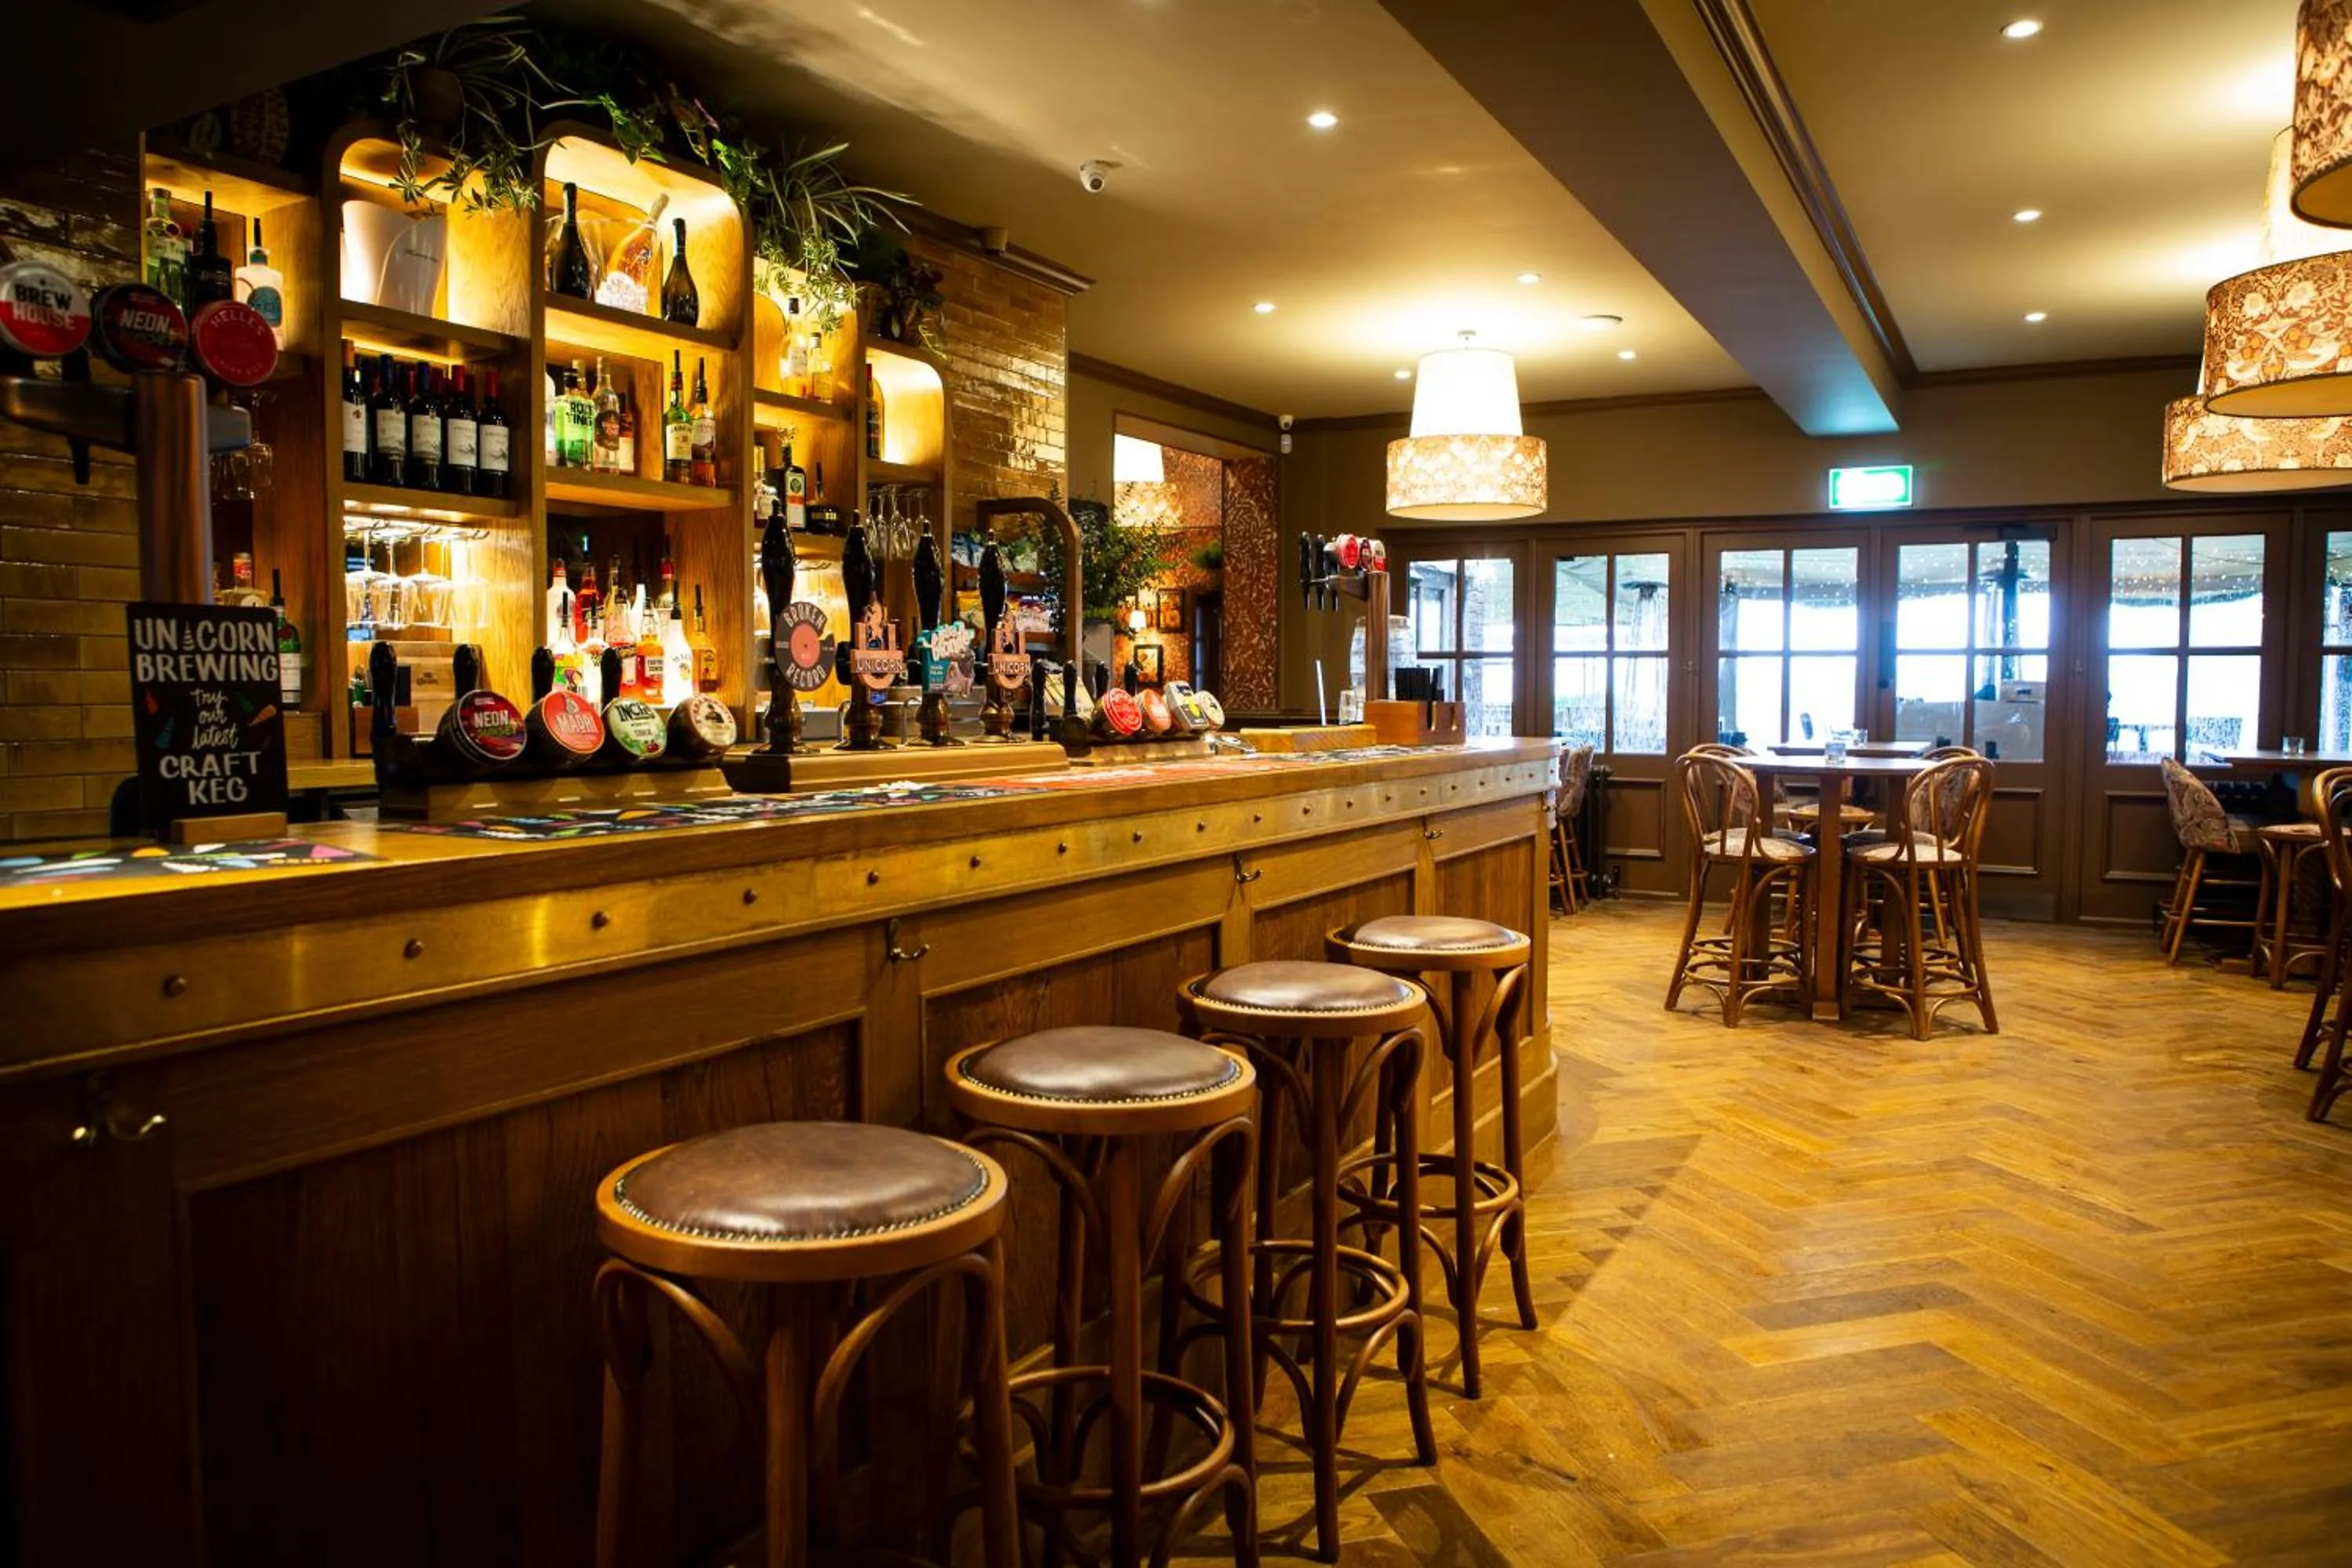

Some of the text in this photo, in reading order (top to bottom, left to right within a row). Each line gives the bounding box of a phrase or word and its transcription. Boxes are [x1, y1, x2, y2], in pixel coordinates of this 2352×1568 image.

[14, 283, 72, 311] BREW
[12, 302, 76, 331] HOUSE
[120, 308, 170, 333] NEON
[783, 603, 826, 629] BROKEN
[136, 653, 278, 682] BREWING
[785, 662, 826, 688] RECORD
[855, 658, 903, 672] UNICORN
[994, 661, 1031, 674] UNICORN
[198, 707, 228, 724] our
[474, 710, 509, 728] NEON
[191, 722, 239, 750] latest
[159, 751, 261, 779] CRAFT
[188, 777, 249, 806] KEG
